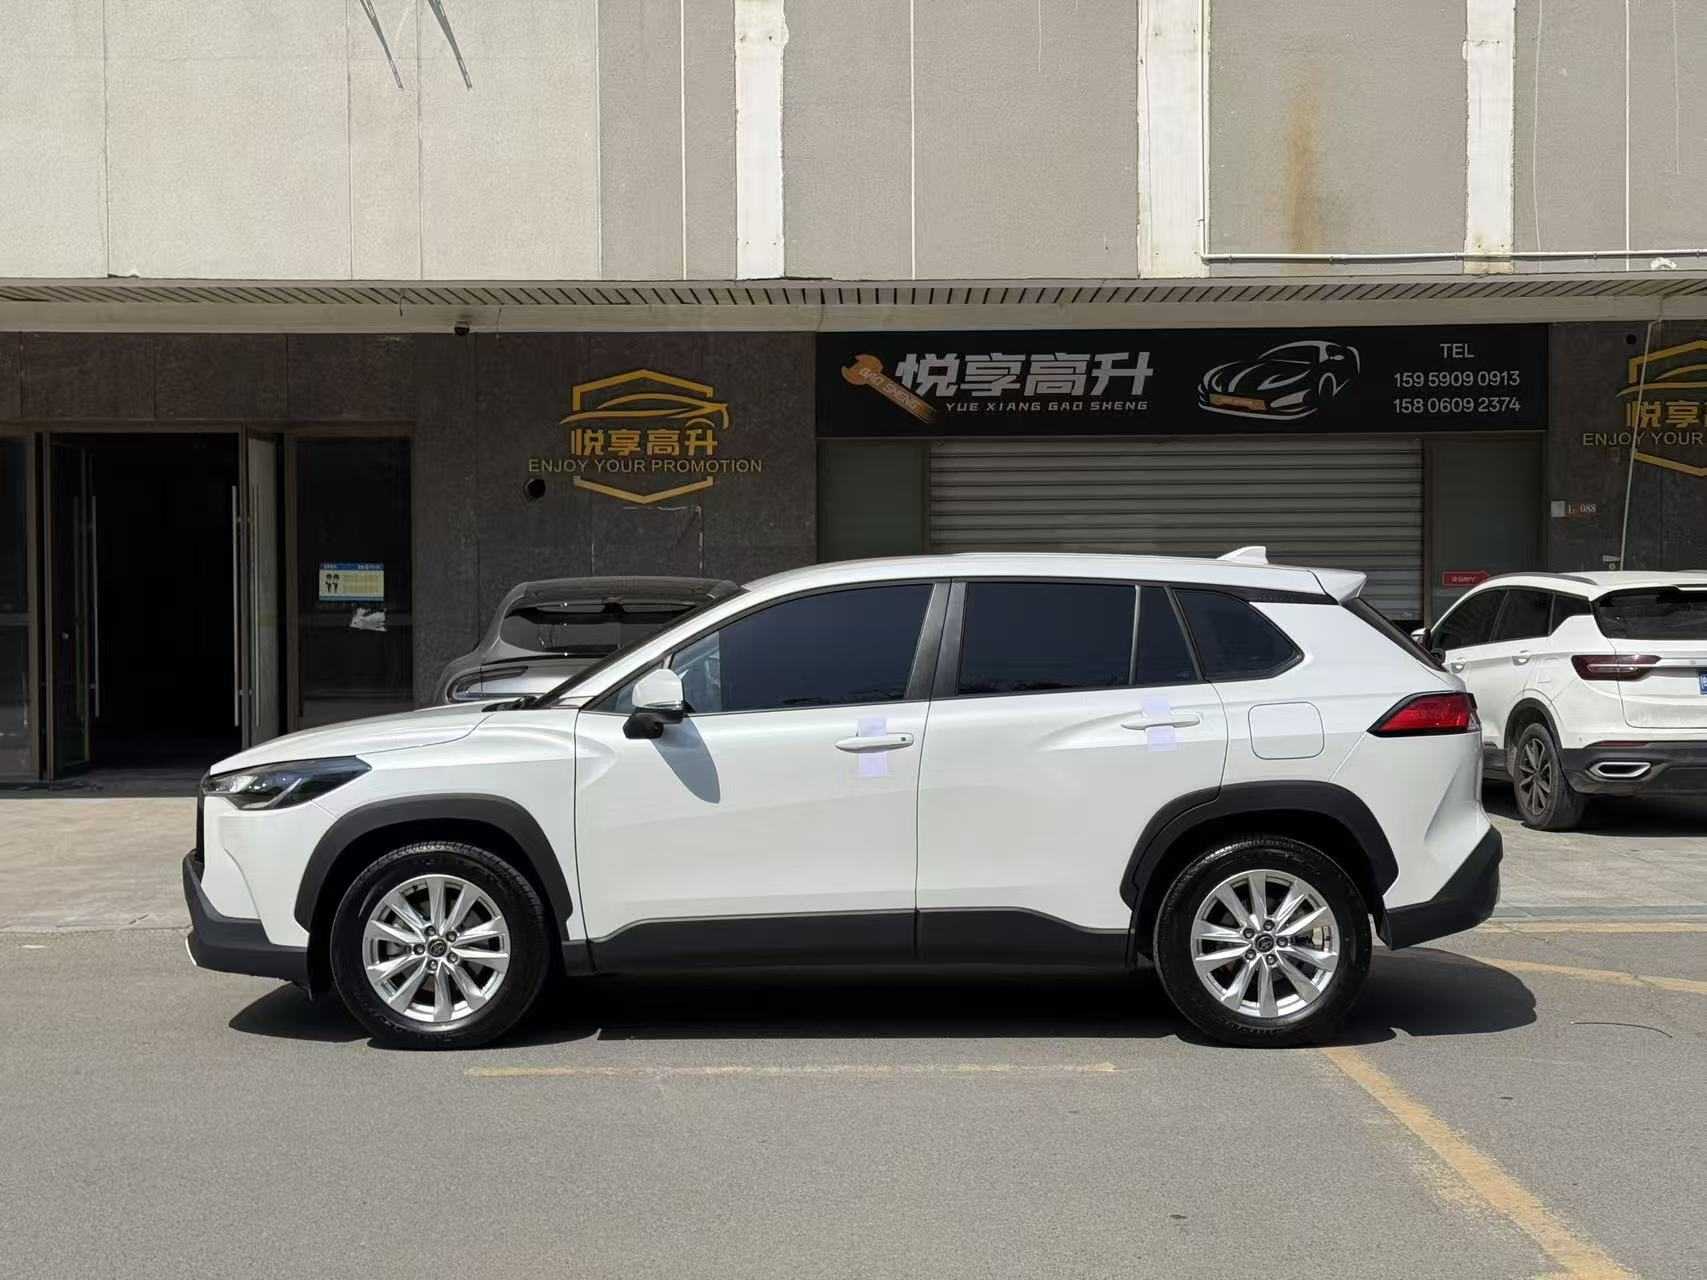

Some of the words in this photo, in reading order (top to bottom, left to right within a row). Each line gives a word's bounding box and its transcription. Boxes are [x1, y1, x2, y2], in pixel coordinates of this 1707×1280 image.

[1440, 343, 1475, 359] TEL
[895, 351, 1155, 397] 悦享高升
[1393, 372, 1425, 388] 159
[1428, 372, 1474, 387] 5909
[1478, 371, 1520, 386] 0913
[945, 401, 979, 412] YUE
[986, 401, 1041, 412] XIANG
[1048, 401, 1083, 412] GAO
[1090, 401, 1149, 411] SHENG
[1393, 399, 1424, 414] 158
[1428, 398, 1474, 413] 0609
[1478, 397, 1521, 413] 2374
[1626, 400, 1707, 428] 悦享
[570, 429, 719, 456] 悦享高升
[1582, 432, 1645, 446] ENJOY
[1650, 432, 1704, 446] YOUR
[528, 459, 589, 473] ENJOY
[594, 459, 646, 473] YOUR
[651, 458, 763, 473] PROMOTION
